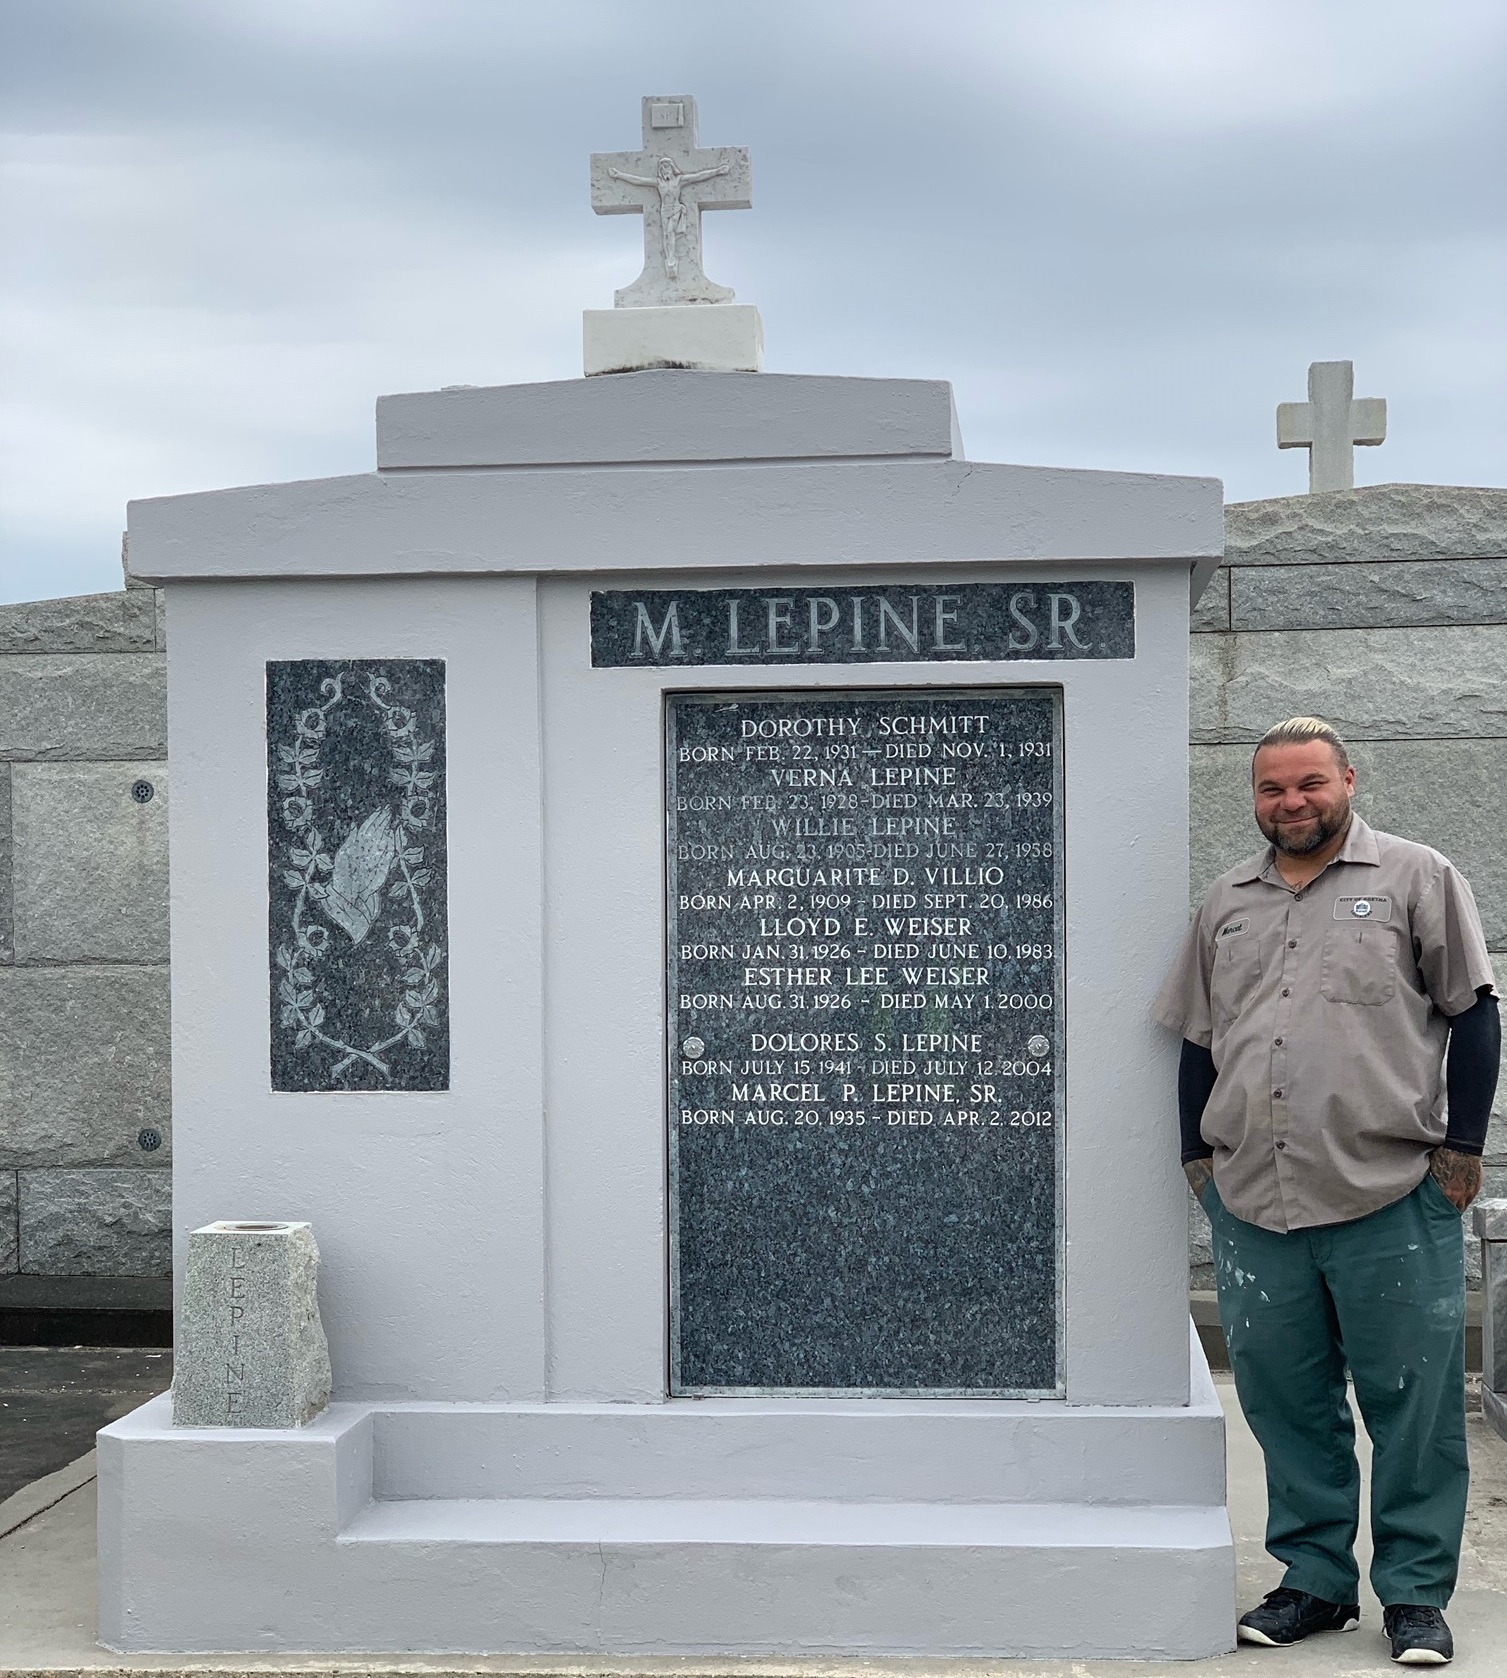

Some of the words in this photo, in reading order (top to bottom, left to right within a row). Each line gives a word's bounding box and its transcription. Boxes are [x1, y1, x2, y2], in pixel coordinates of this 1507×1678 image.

[629, 601, 702, 658] M.
[1008, 592, 1108, 651] SR.
[741, 718, 861, 738] DOROTHY
[879, 715, 990, 736] SCHMITT
[679, 747, 734, 762] BORN
[746, 746, 785, 761] FEB.
[792, 745, 819, 762] 22,
[942, 743, 988, 758] NOV.
[1000, 742, 1012, 759] 1,
[1019, 741, 1051, 757] 1931
[771, 769, 853, 787] VERNA
[871, 767, 956, 786] LEPINE
[677, 795, 731, 811] BORN
[742, 795, 781, 810] FEB.
[788, 794, 814, 811] 23,
[928, 793, 978, 808] MAR.
[984, 793, 1010, 810] 23,
[1016, 792, 1052, 808] 1939
[771, 818, 855, 836] WILLIE
[872, 817, 956, 835] LEPINE
[678, 844, 734, 860] BORN
[746, 844, 790, 860] AUG.
[926, 843, 977, 858] JUNE
[985, 843, 1009, 860] 27,
[1015, 842, 1052, 858] 1958
[727, 868, 881, 887] MARGUARITE
[894, 868, 915, 885] D.
[925, 866, 1004, 886] VILLIO
[680, 895, 732, 910] BORN
[740, 895, 782, 909] APR.
[787, 894, 804, 911] 2,
[811, 894, 851, 910] 1909
[872, 894, 916, 909] DIED
[924, 894, 972, 909] SEPT.
[1016, 893, 1053, 909] 1986
[761, 918, 841, 936] LLOYD
[855, 918, 874, 936] E.
[885, 918, 972, 936] WEISER
[681, 944, 734, 960] BORN
[742, 944, 785, 959] JAN.
[813, 944, 851, 959] 1926
[874, 944, 919, 959] DIED
[928, 944, 979, 959] JUNE
[1016, 944, 1053, 959] 1983
[744, 968, 832, 986] ESTHER
[846, 967, 888, 985] LEE
[902, 967, 990, 985] WEISER
[680, 994, 733, 1009] BORN
[742, 994, 786, 1009] AUG.
[814, 994, 851, 1009] 1926
[881, 994, 927, 1009] DIED
[935, 994, 975, 1009] MAY
[998, 994, 1052, 1009] 2000
[751, 1033, 859, 1052] DOLORES
[875, 1033, 891, 1051] S.
[902, 1033, 982, 1052] LEPINE
[682, 1060, 732, 1075] BORN
[740, 1060, 786, 1075] JULY
[819, 1060, 851, 1075] 1941
[872, 1060, 916, 1075] DIED
[924, 1060, 968, 1075] JULY
[1002, 1060, 1051, 1075] 2004
[731, 1083, 825, 1102] MARCEL
[843, 1083, 858, 1102] P.
[873, 1084, 960, 1104] LEPINE,
[970, 1084, 1002, 1102] SR.
[681, 1109, 734, 1125] BORN
[744, 1109, 789, 1125] AUG.
[794, 1110, 822, 1126] 20,
[829, 1110, 865, 1125] 1935
[887, 1111, 933, 1126] DIED
[943, 1111, 985, 1126] APR.
[1010, 1111, 1052, 1126] 2012
[226, 1246, 246, 1414] LEPINE
